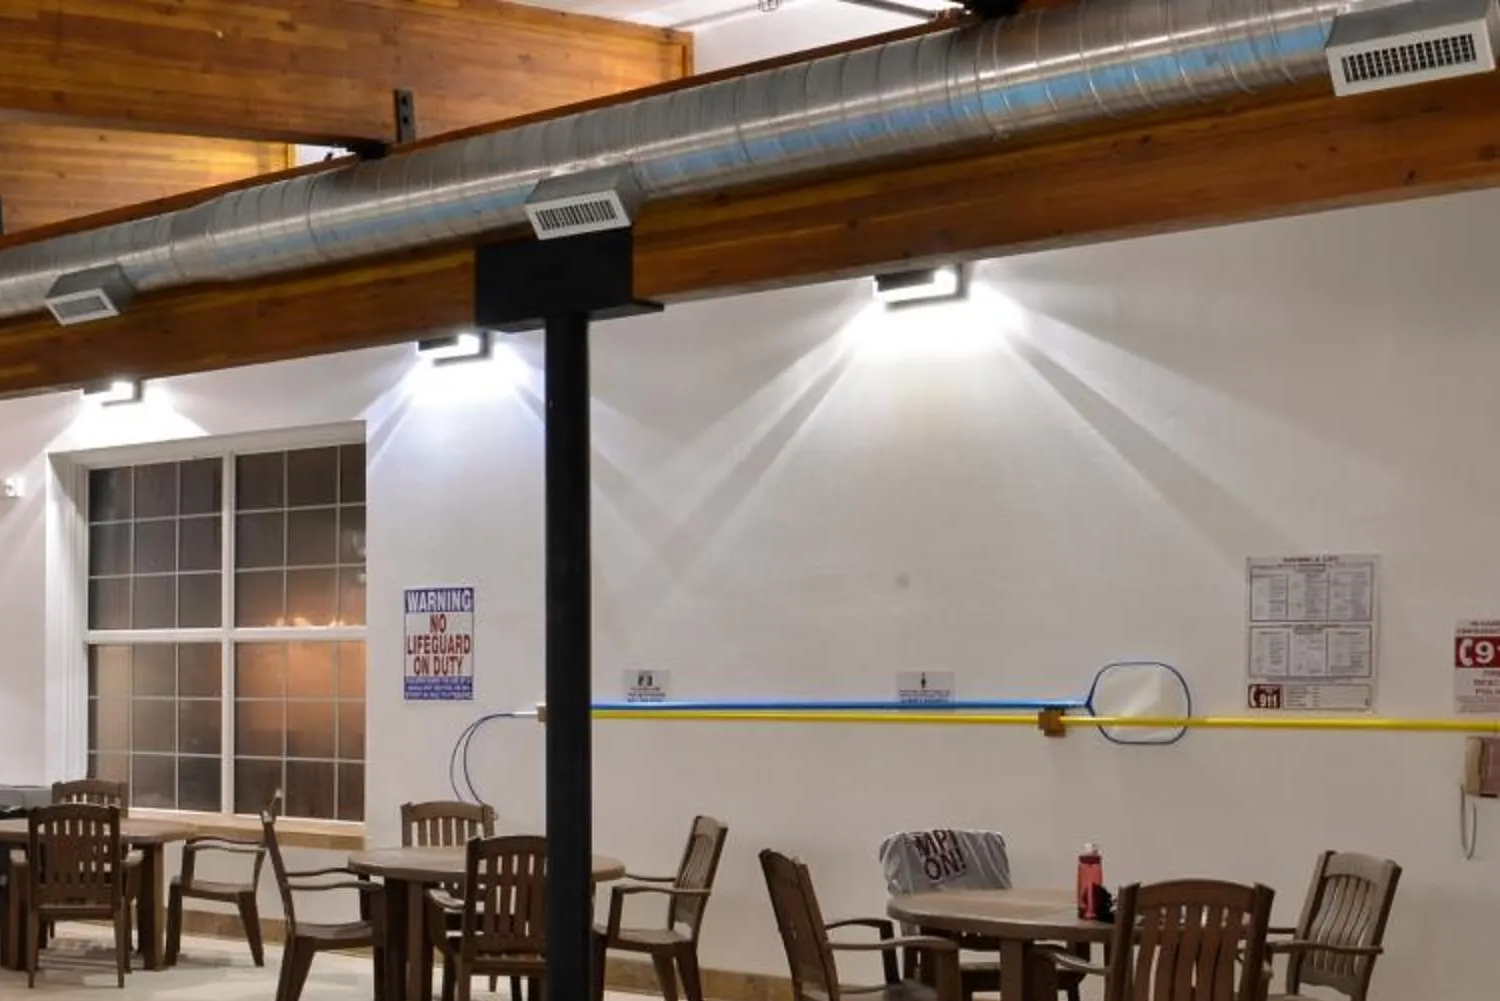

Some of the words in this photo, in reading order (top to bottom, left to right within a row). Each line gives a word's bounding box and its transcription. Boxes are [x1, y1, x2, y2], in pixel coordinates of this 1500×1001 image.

[407, 589, 472, 611] WARNING
[430, 614, 447, 633] NO
[407, 634, 471, 655] LIFEGUARD
[414, 656, 429, 675] ON
[434, 656, 464, 675] DUTY
